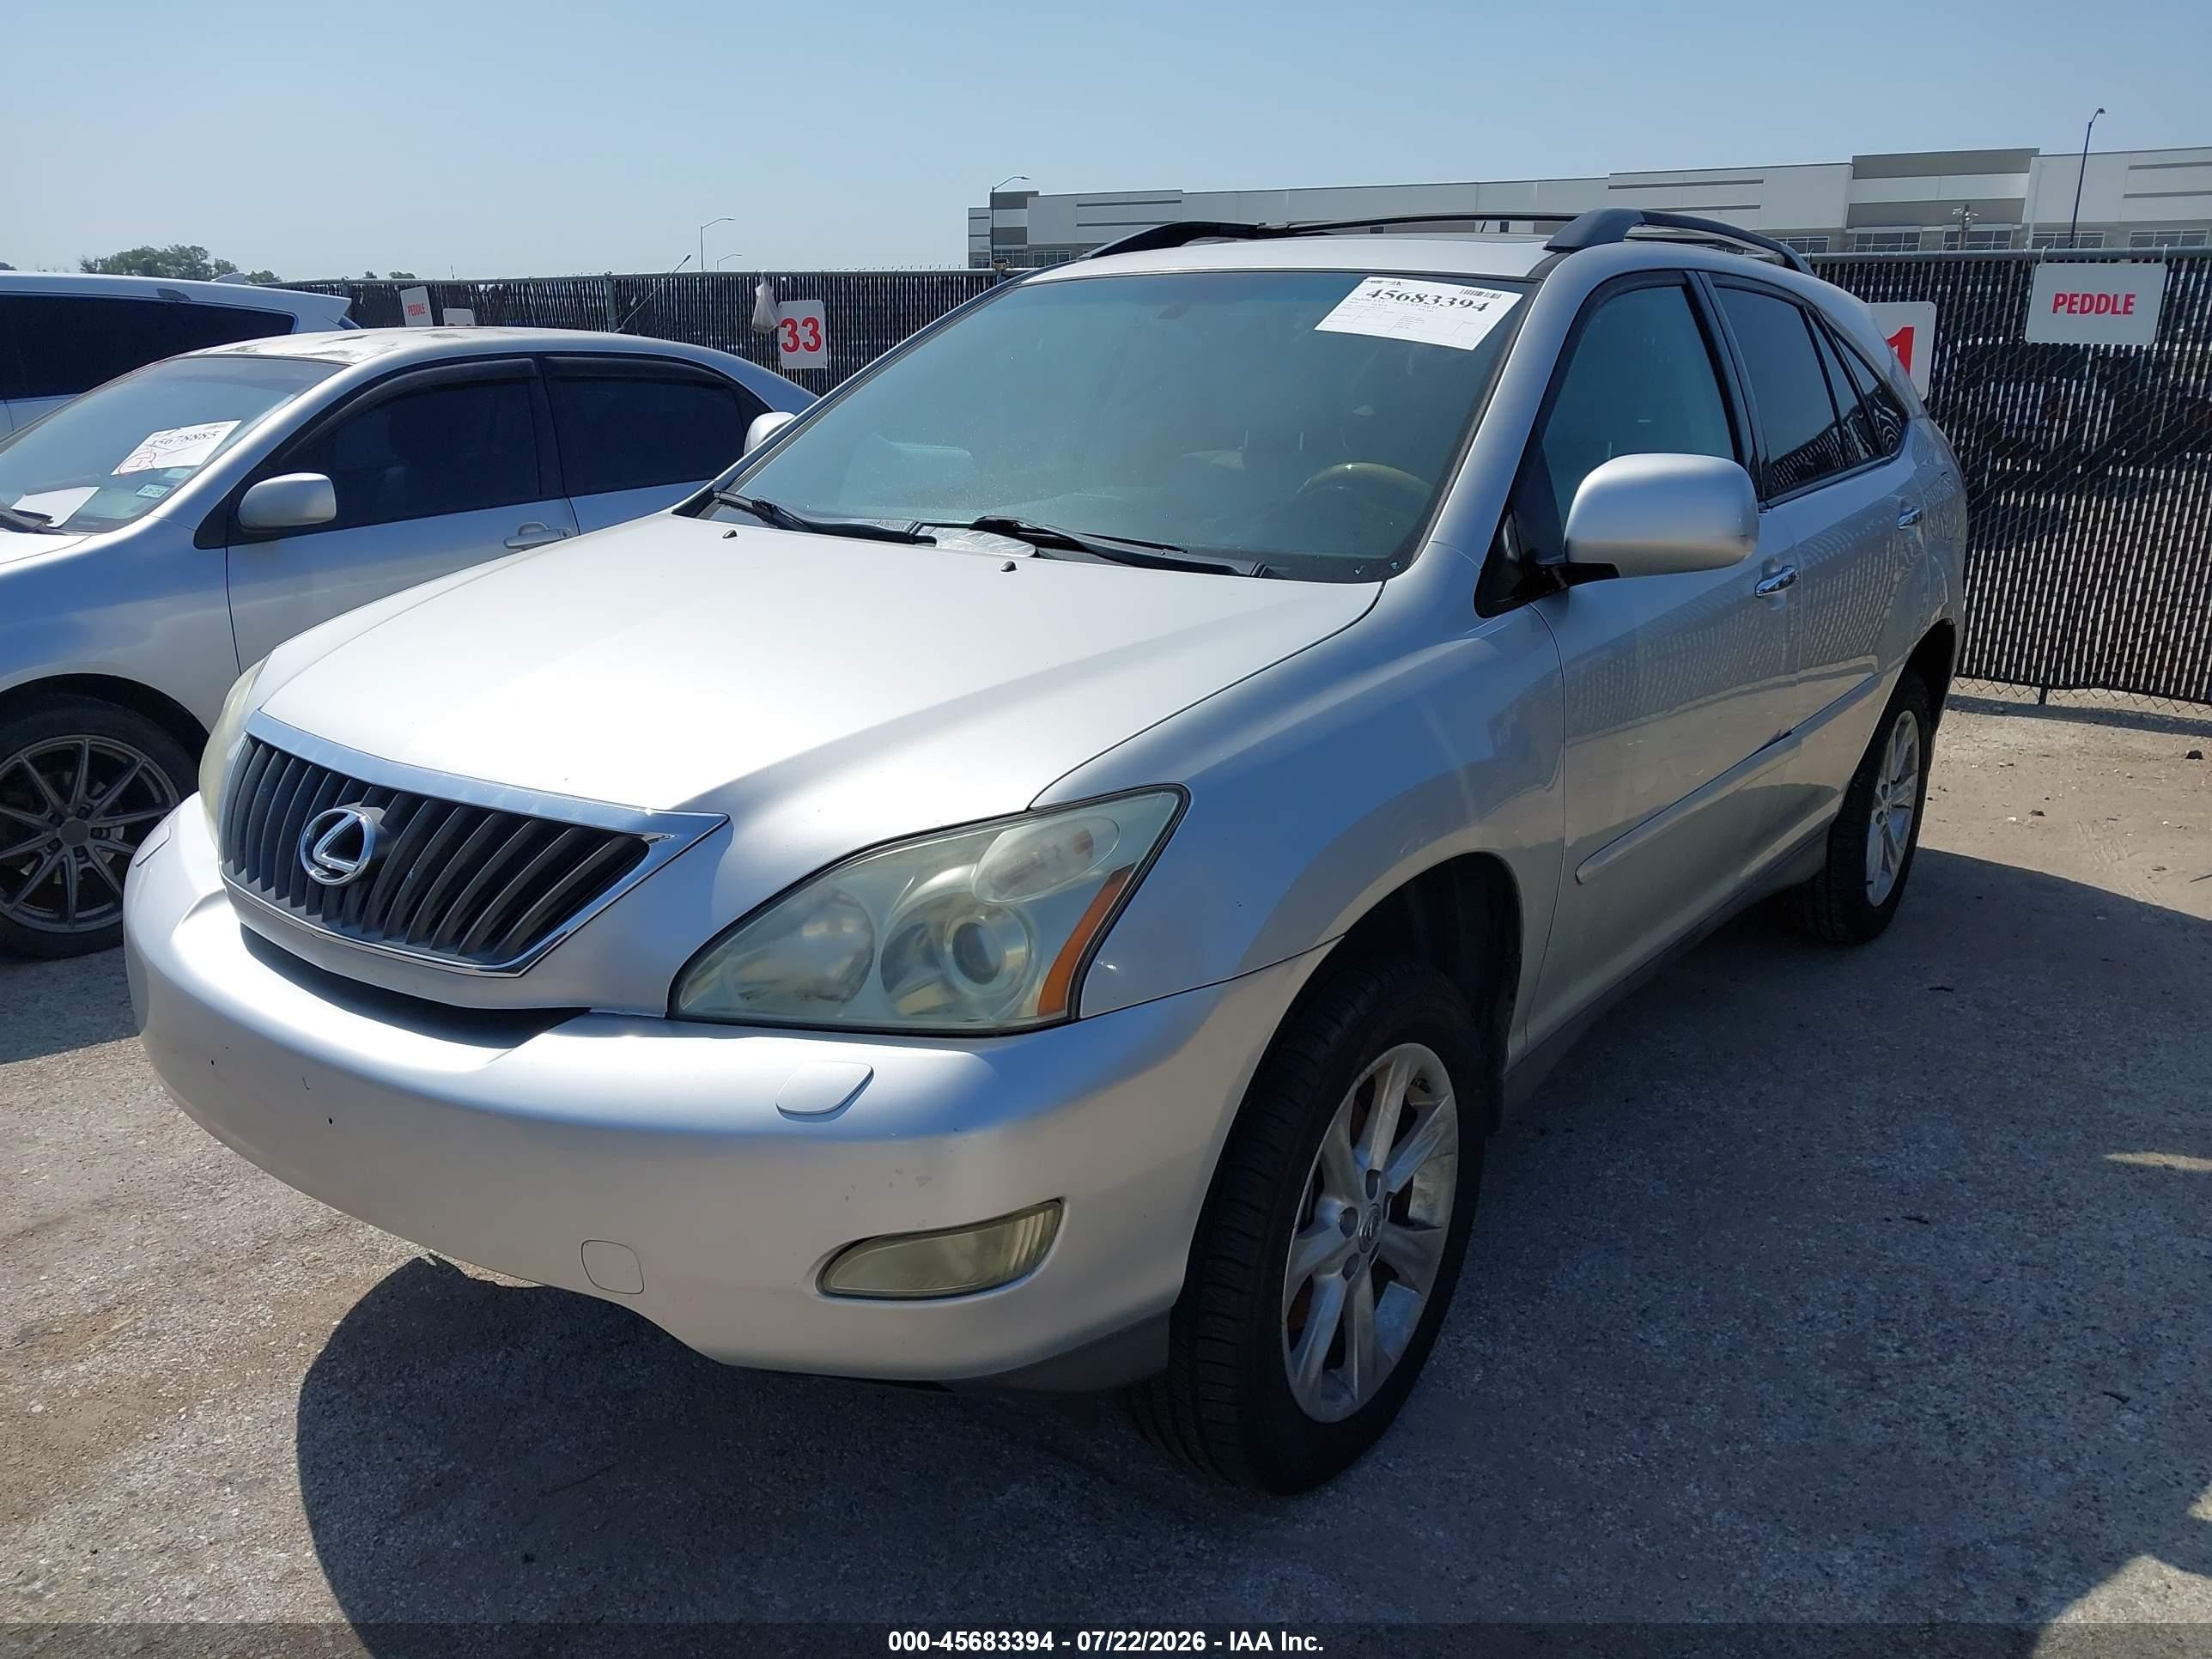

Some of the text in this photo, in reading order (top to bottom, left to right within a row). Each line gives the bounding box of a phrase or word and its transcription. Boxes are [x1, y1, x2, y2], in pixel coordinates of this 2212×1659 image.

[1365, 288, 1492, 312] 45683394
[2051, 293, 2136, 315] PEDDLE
[780, 316, 822, 353] 33
[1887, 326, 1915, 377] 1
